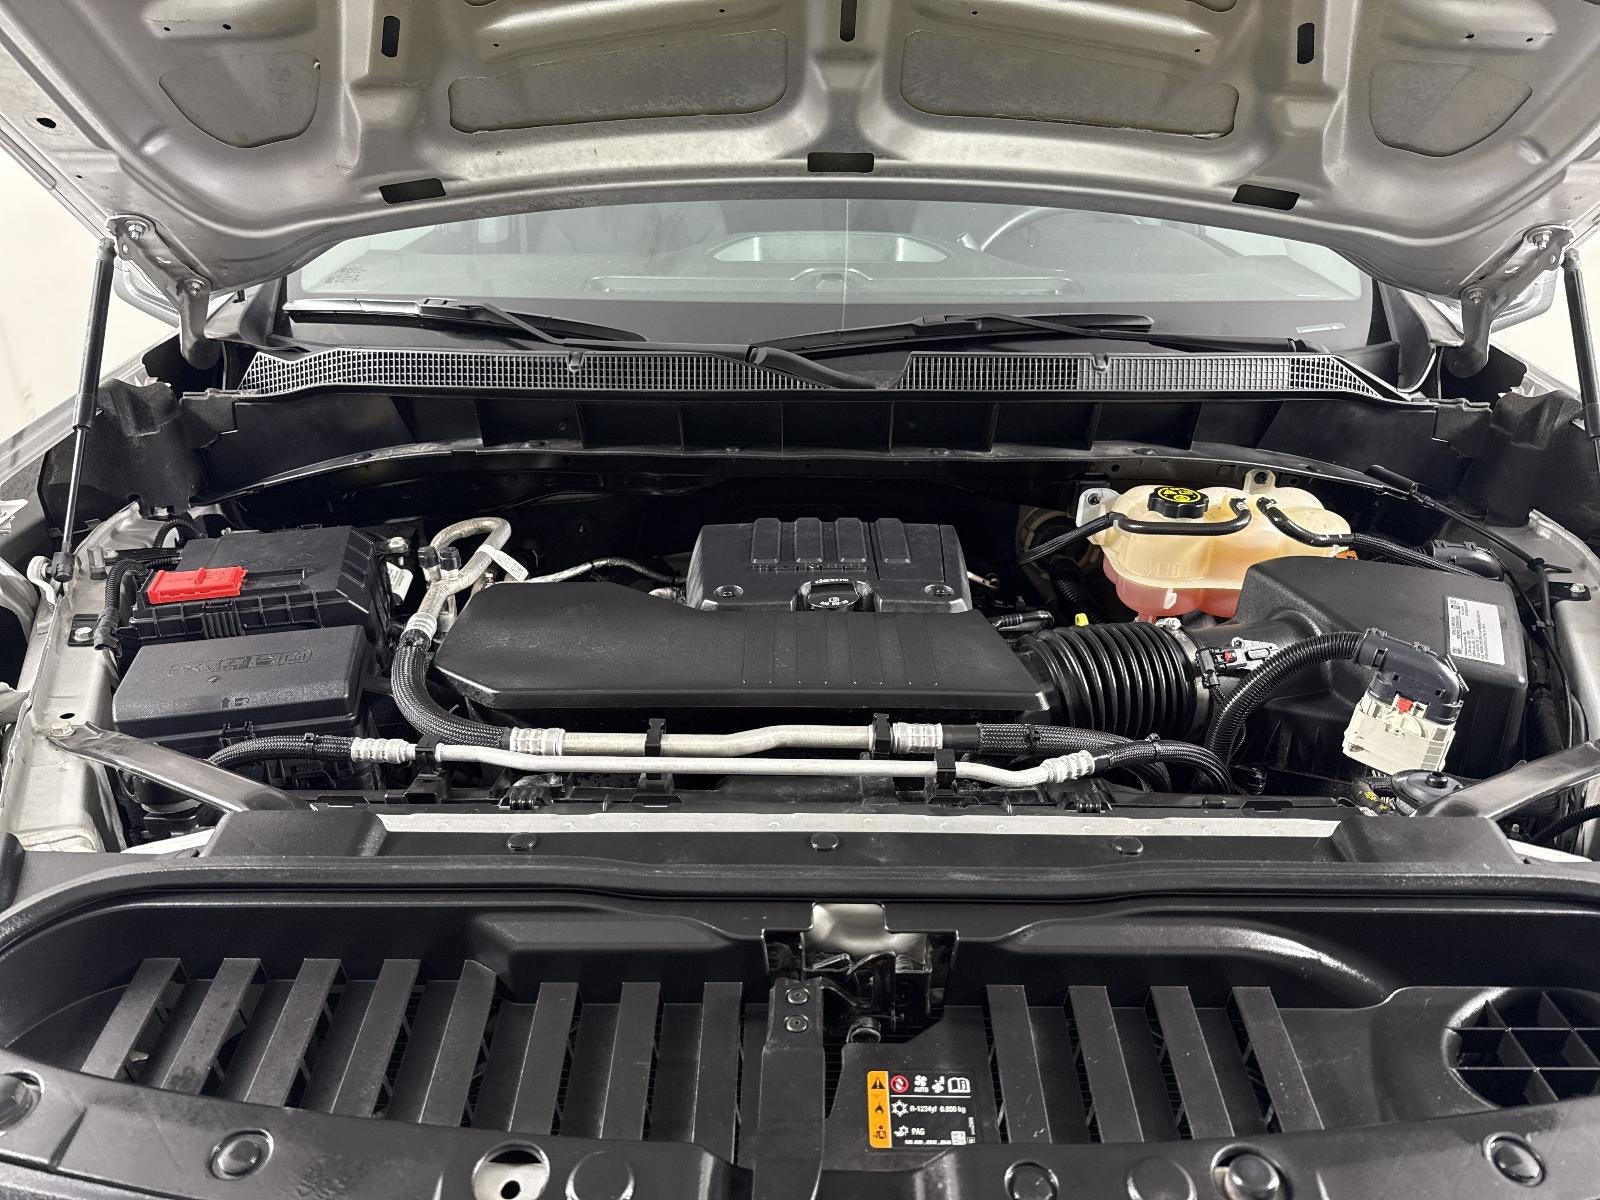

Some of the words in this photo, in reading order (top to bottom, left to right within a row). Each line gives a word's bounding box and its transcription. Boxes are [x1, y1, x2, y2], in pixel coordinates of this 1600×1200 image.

[909, 1105, 937, 1114] R-1234yf
[957, 1105, 967, 1114] kg
[911, 1127, 926, 1136] PAG
